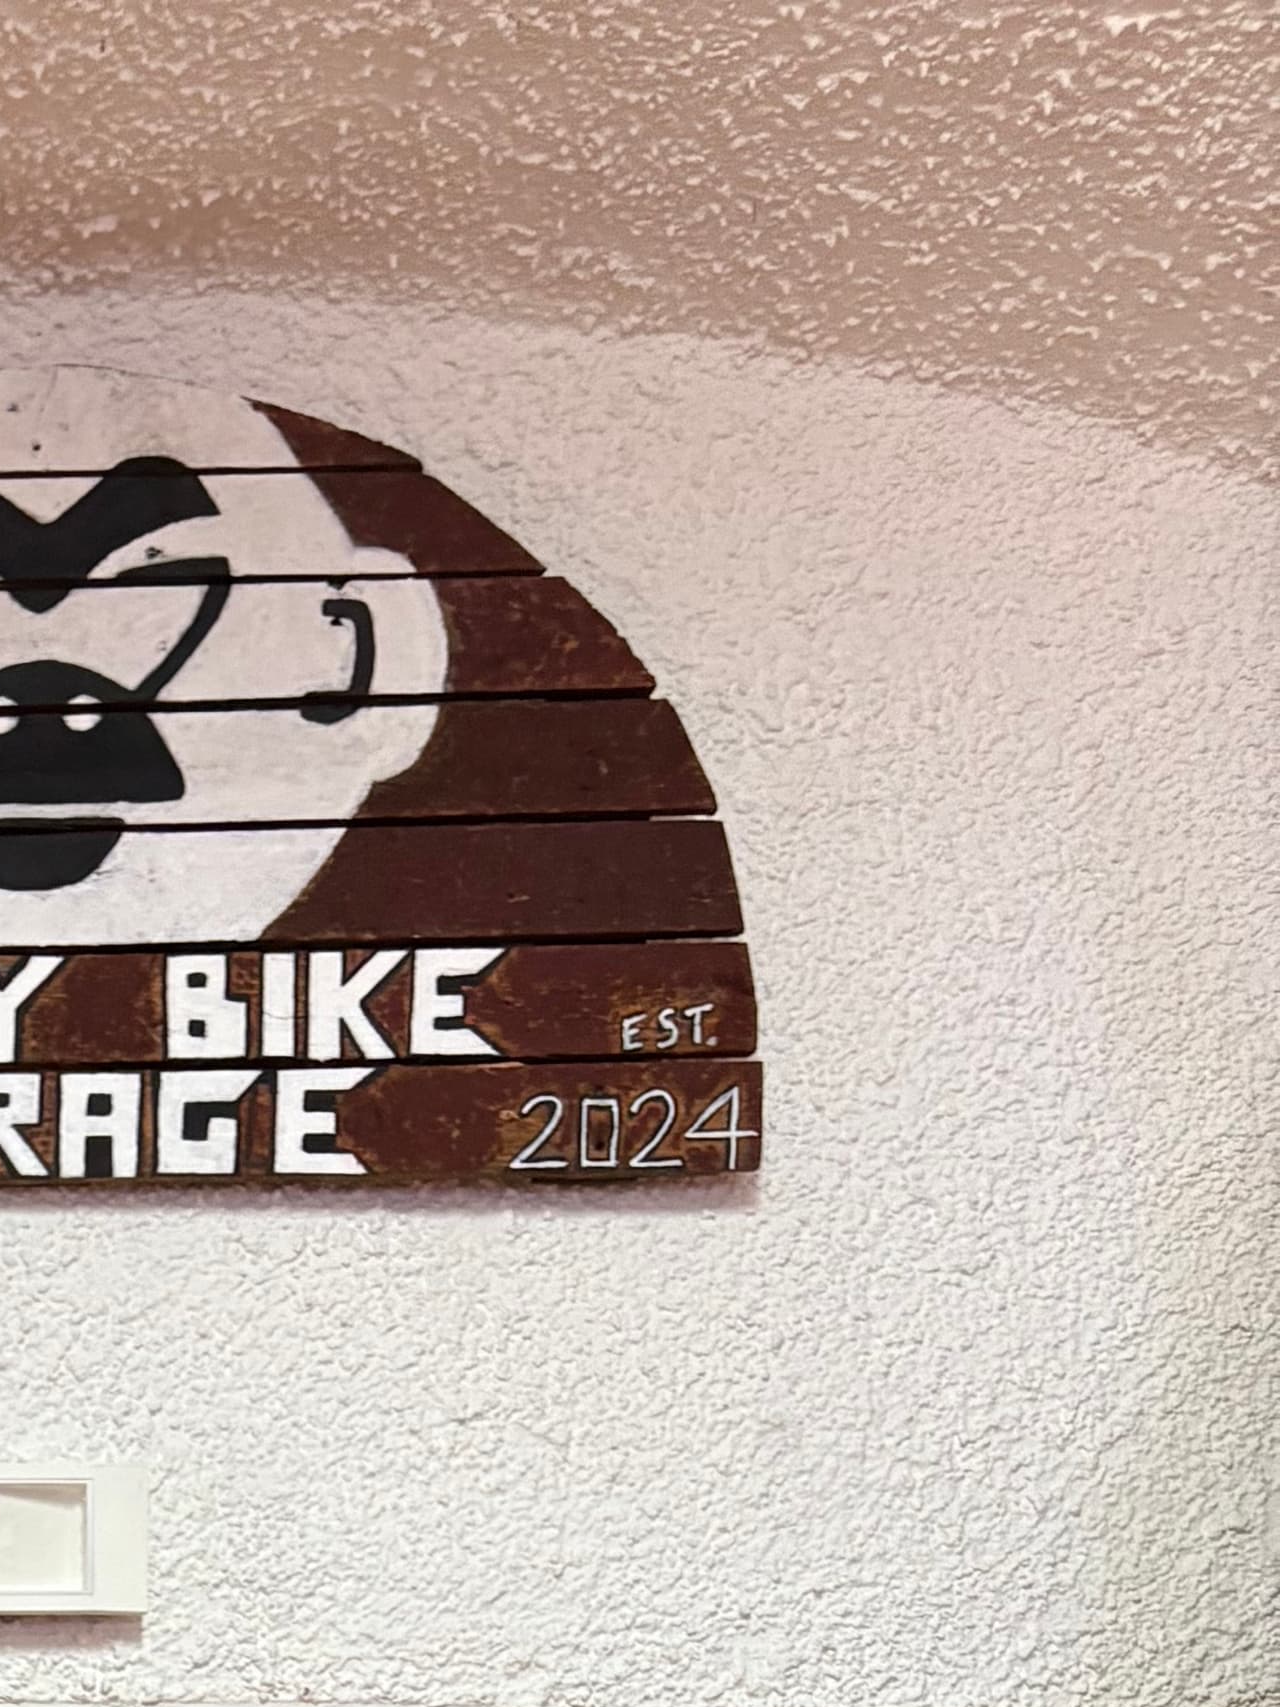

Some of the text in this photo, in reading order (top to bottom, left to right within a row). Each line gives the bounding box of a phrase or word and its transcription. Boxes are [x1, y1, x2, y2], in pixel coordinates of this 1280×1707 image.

[165, 948, 507, 1060] BIKE
[621, 1003, 717, 1052] EST.
[508, 1085, 758, 1171] 2024
